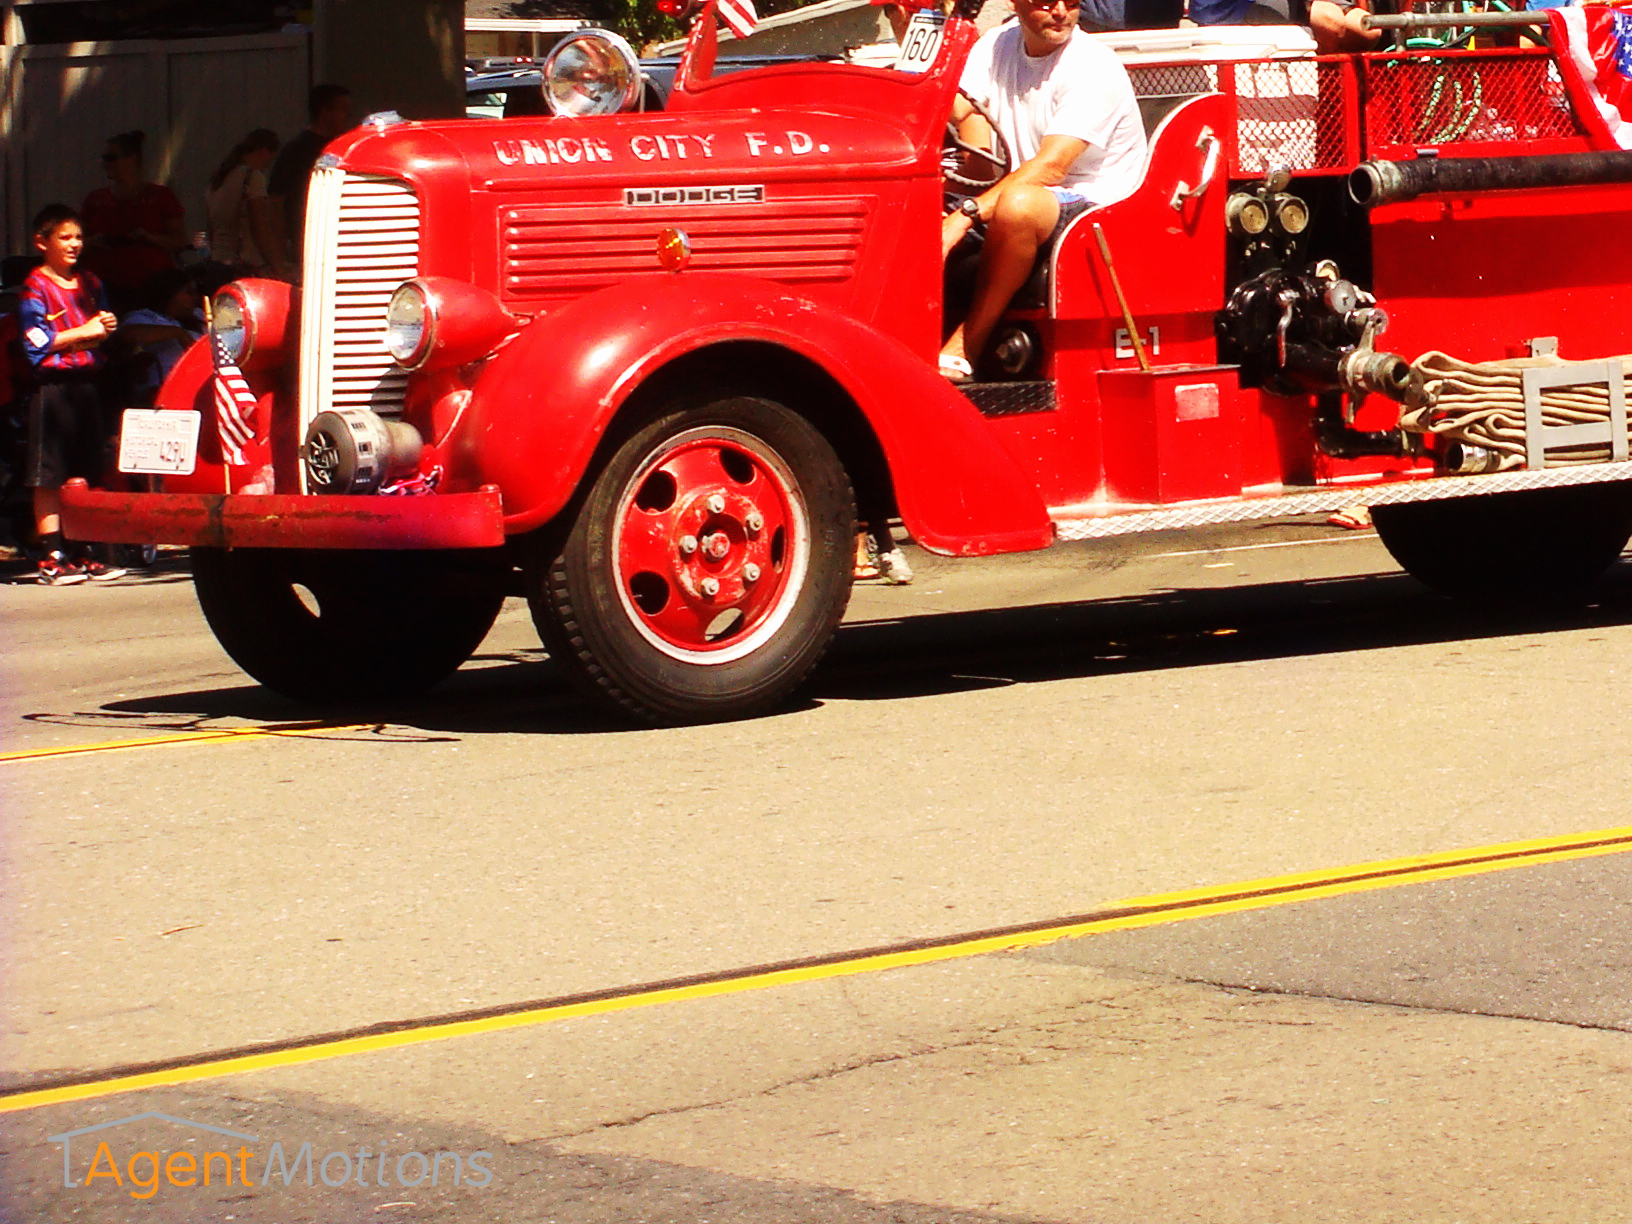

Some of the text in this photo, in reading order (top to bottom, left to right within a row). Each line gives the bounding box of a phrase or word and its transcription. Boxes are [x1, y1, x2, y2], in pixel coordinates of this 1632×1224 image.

[901, 28, 939, 63] 160
[493, 131, 830, 166] UNION CITY F.D.
[625, 186, 764, 206] DODGE
[1115, 325, 1160, 359] E-1
